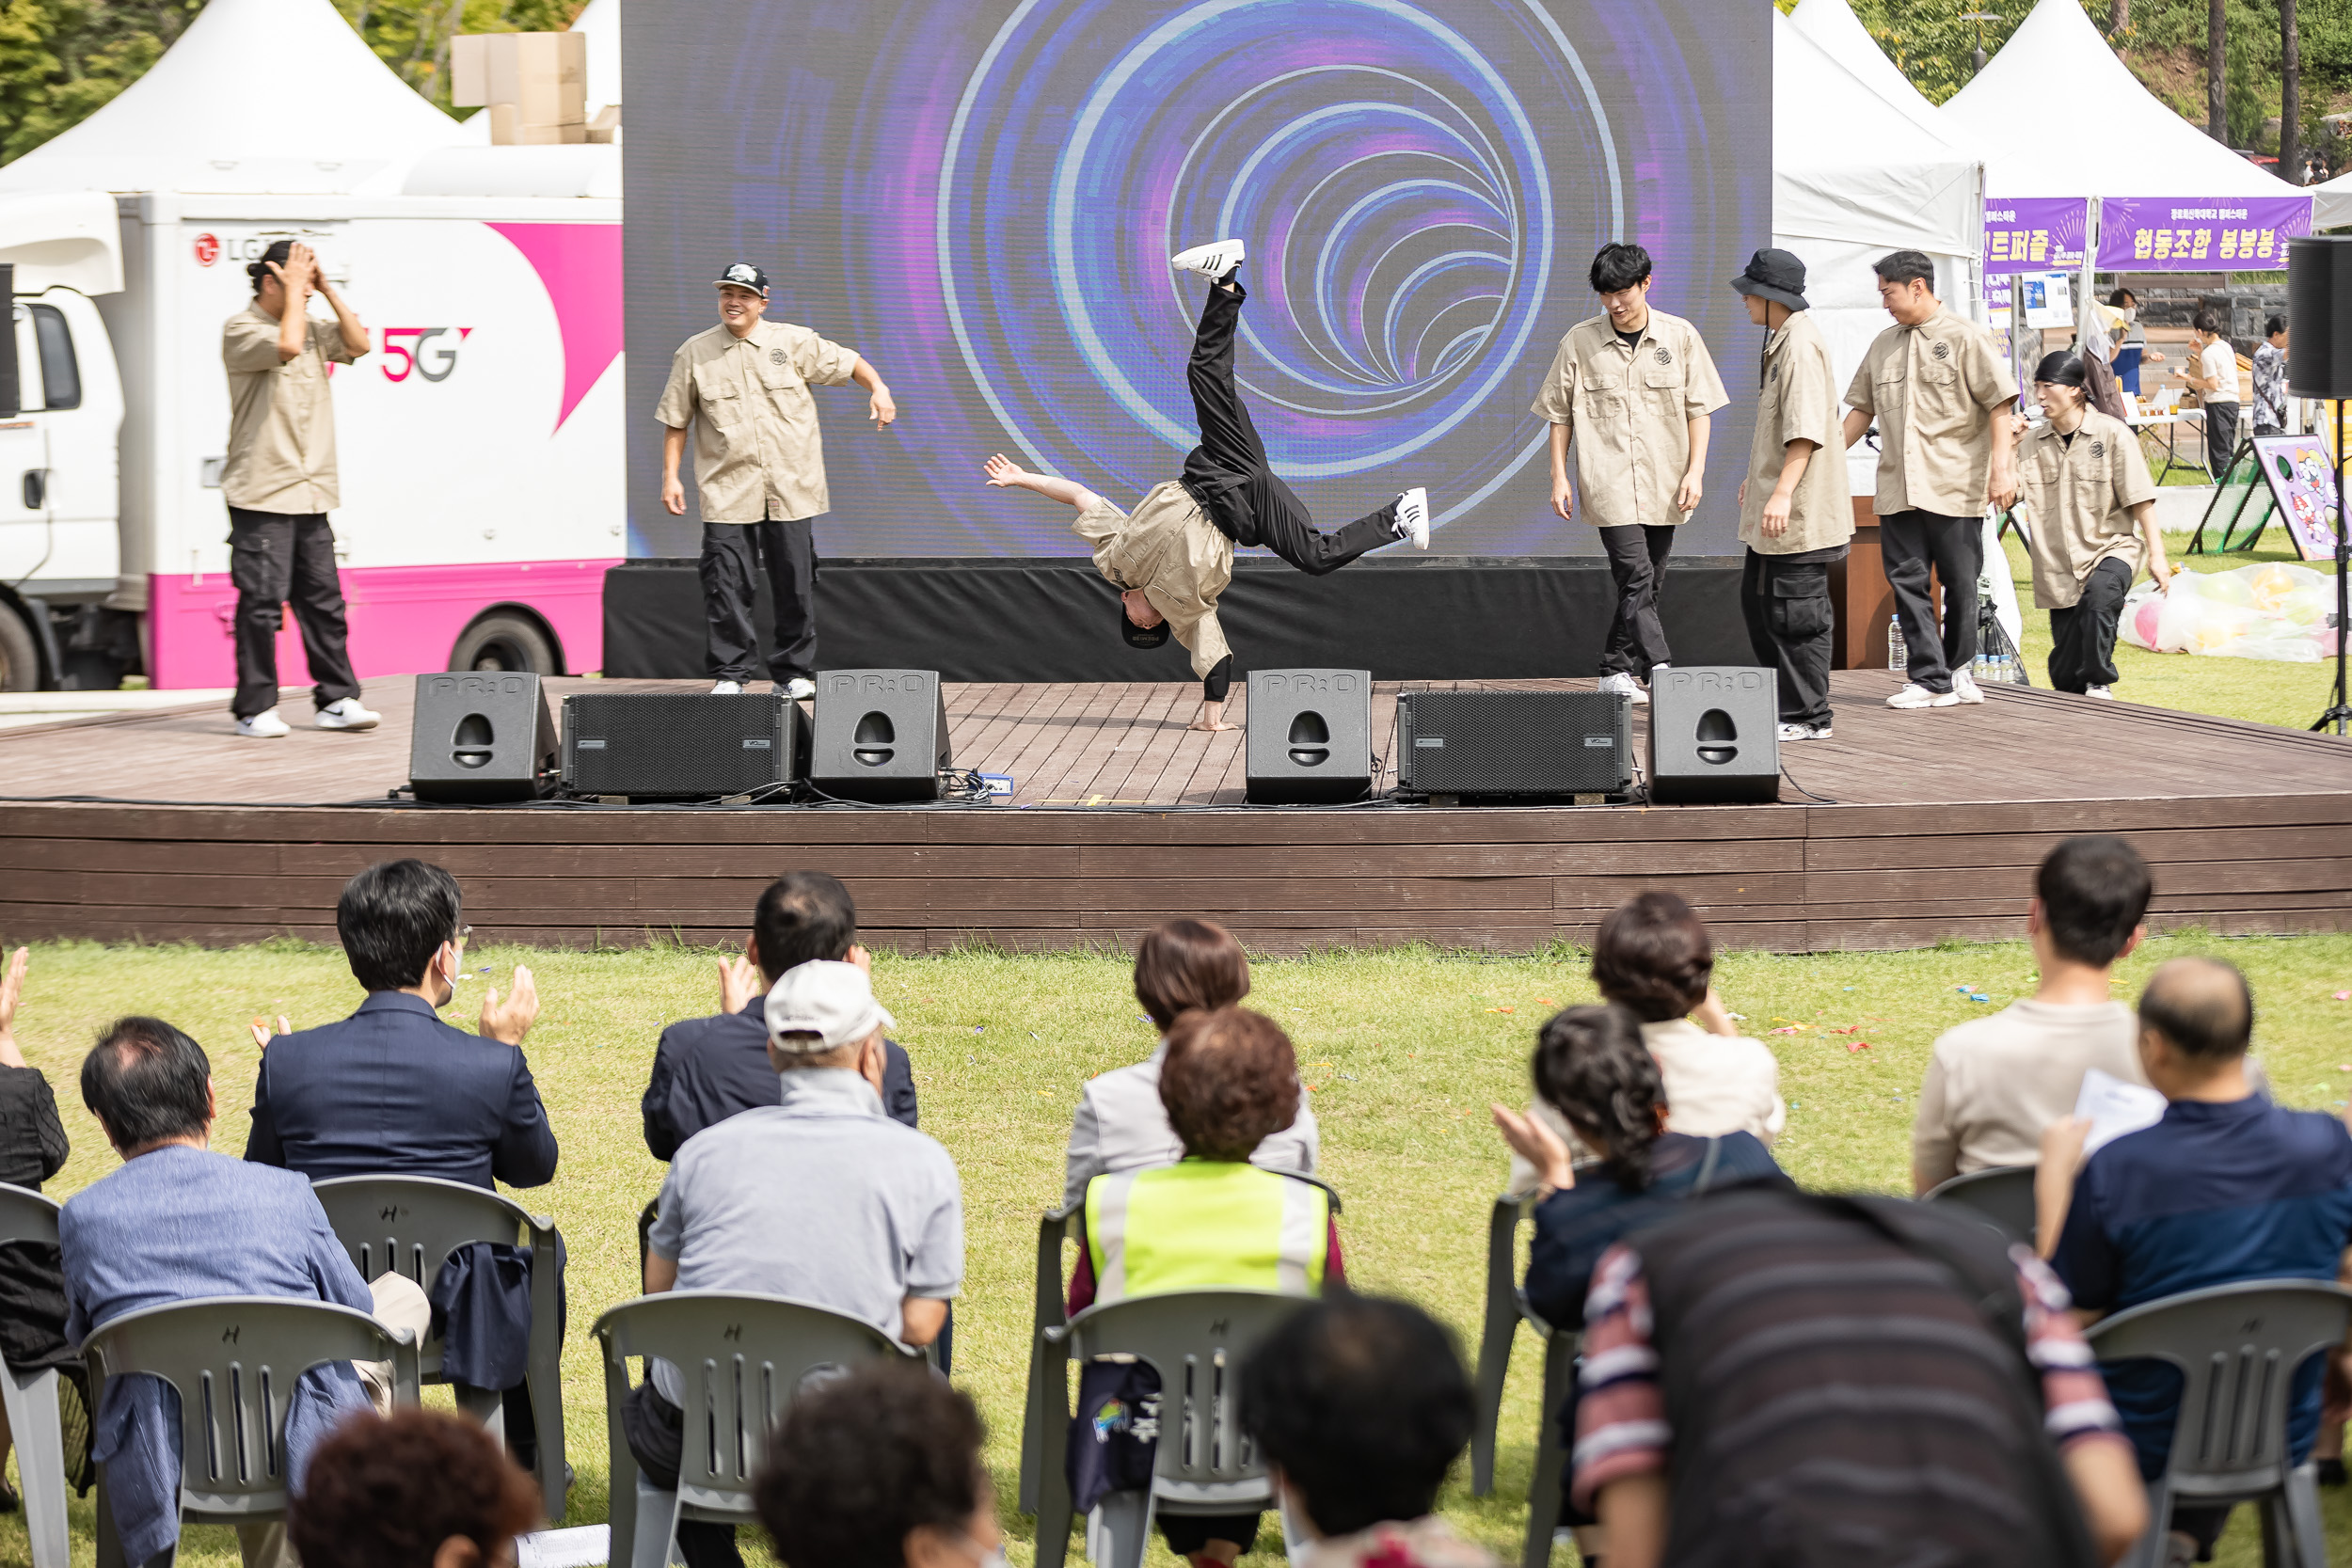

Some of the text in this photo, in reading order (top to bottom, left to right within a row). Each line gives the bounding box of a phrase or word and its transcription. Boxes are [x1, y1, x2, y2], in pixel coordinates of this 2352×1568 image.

[2134, 229, 2212, 260] 협동조합
[2219, 228, 2276, 260] 봉봉봉
[382, 327, 456, 382] 5G
